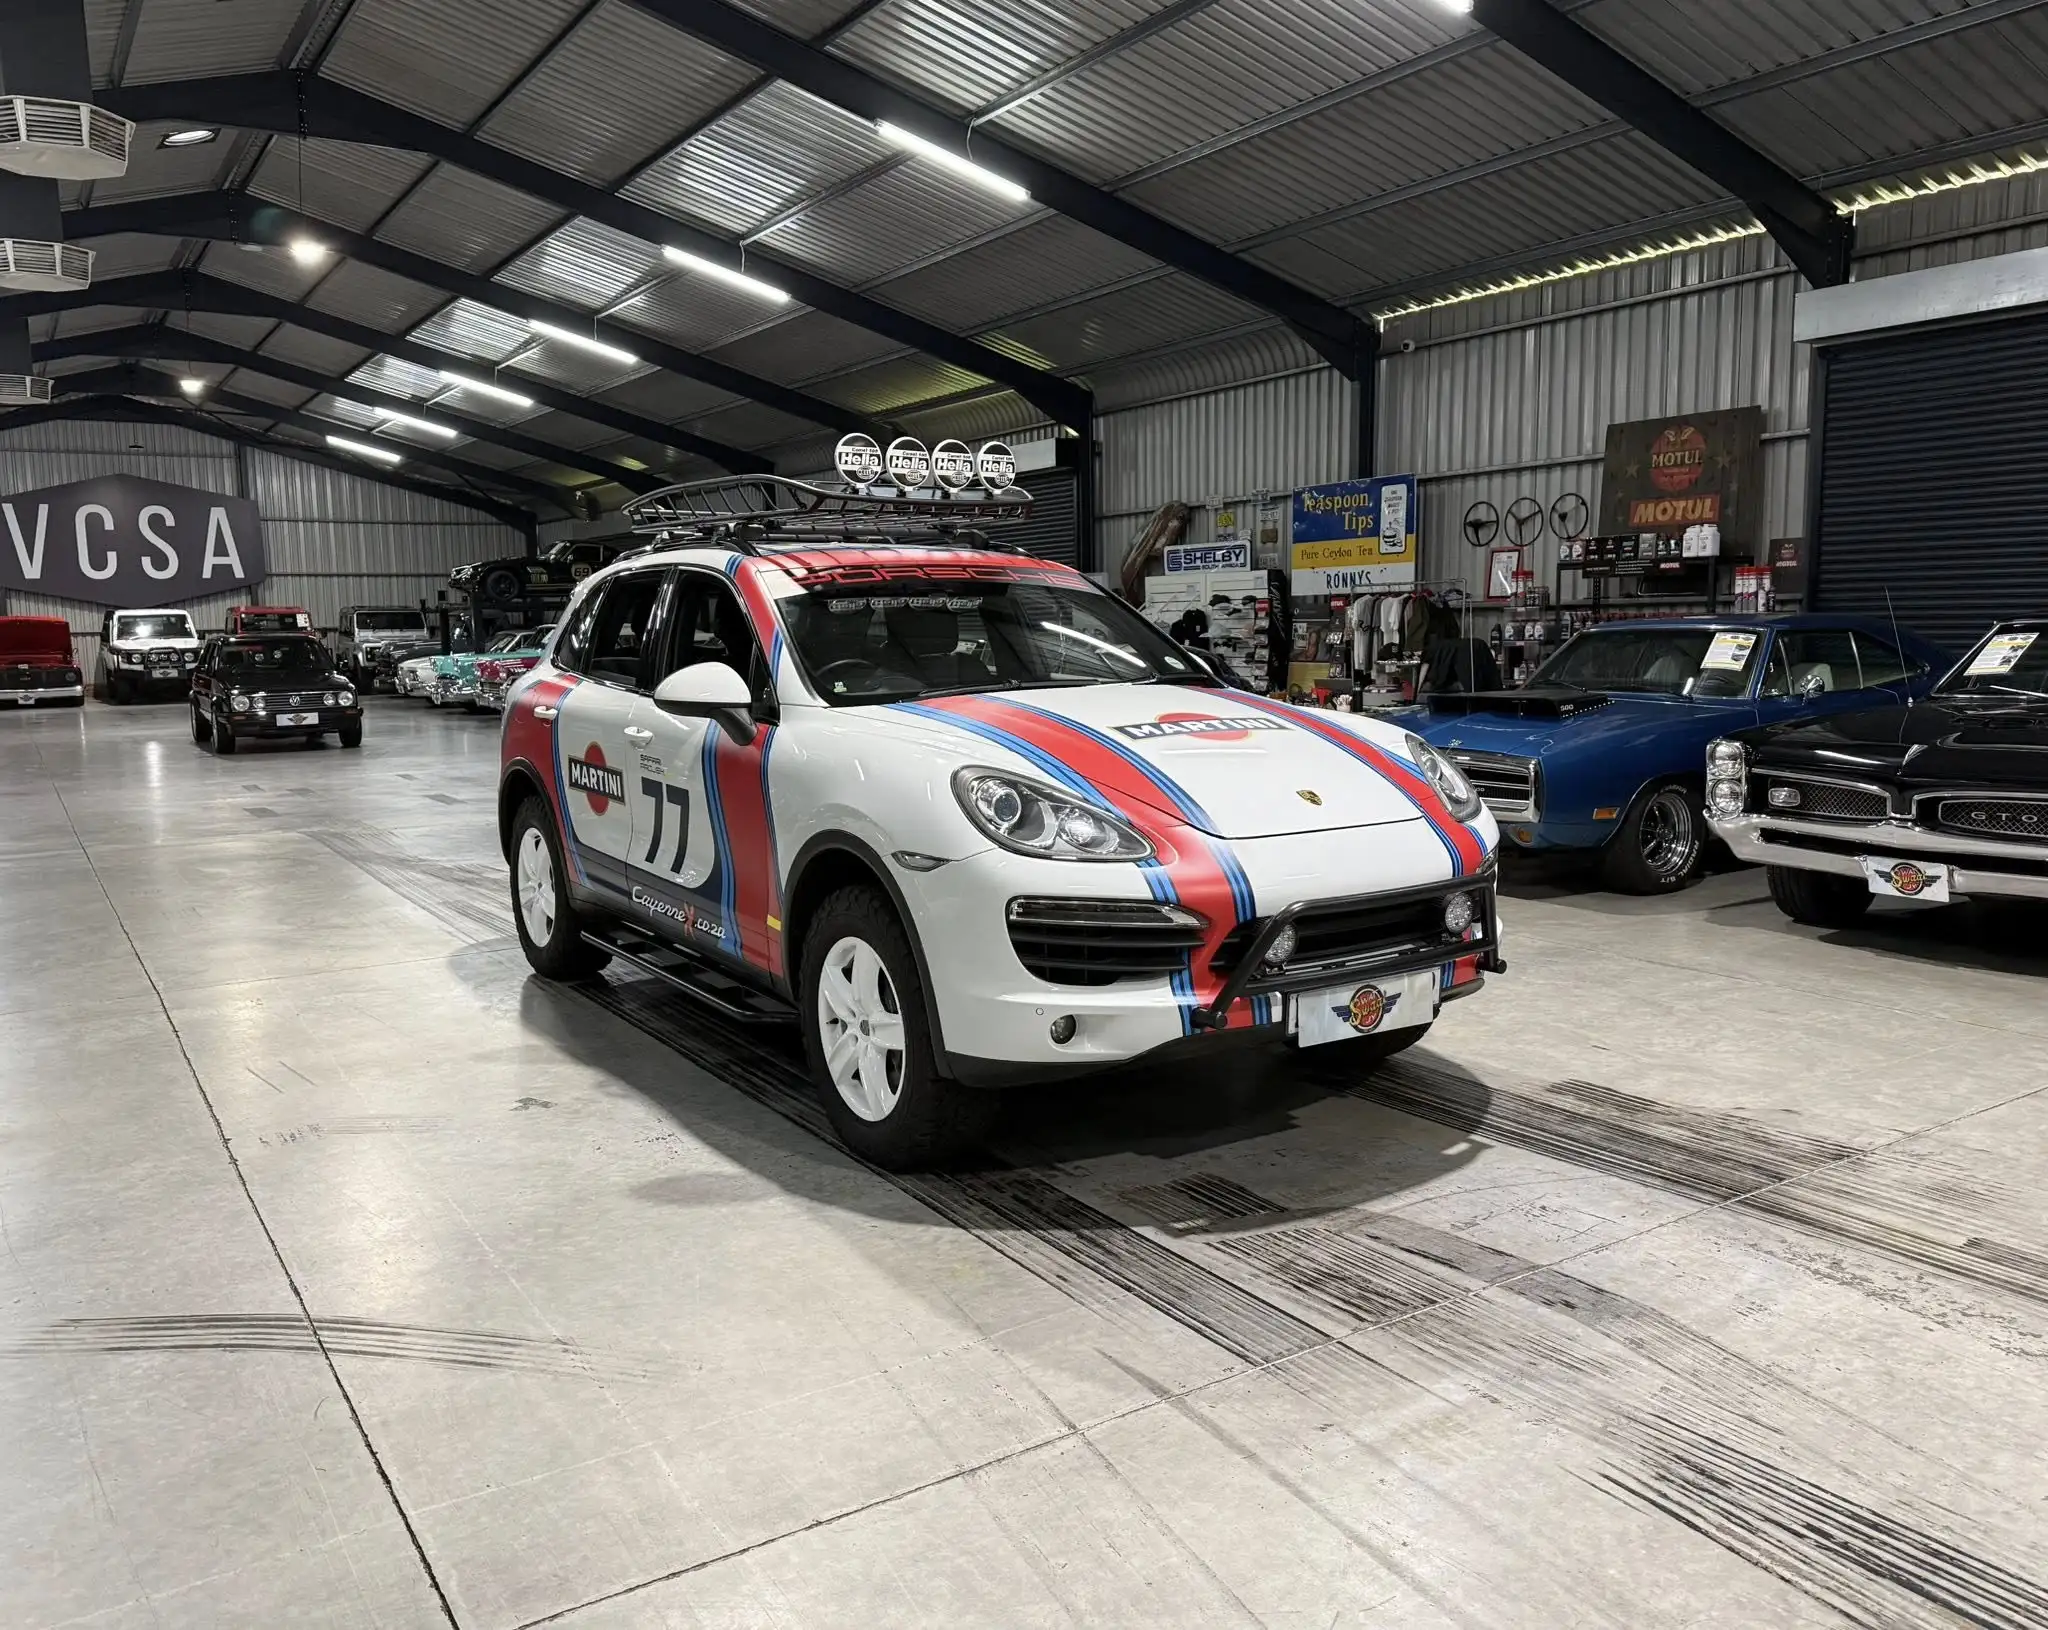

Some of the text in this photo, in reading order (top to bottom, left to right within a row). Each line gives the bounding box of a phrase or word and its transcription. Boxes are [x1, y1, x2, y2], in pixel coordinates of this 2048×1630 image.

[840, 452, 879, 466] Hella
[891, 456, 927, 471] Hella
[937, 459, 971, 473] Hella
[982, 461, 1013, 474] Hella
[1652, 450, 1703, 468] MOTUL
[1302, 493, 1369, 516] Teaspoon
[1634, 498, 1714, 524] MOTUL
[1342, 511, 1375, 535] Tips
[1, 503, 246, 580] VCSA
[1183, 549, 1243, 565] SHELBY
[1301, 544, 1373, 561] Pure Ceylon Tea
[574, 567, 590, 577] 69
[795, 567, 1091, 589] PORSCHE
[1326, 570, 1372, 589] RONNYS
[1124, 718, 1277, 737] MARTINI
[571, 761, 622, 798] MARTINI
[641, 776, 690, 874] 77
[1971, 811, 2038, 823] GTO
[1677, 839, 1700, 877] RADIAL
